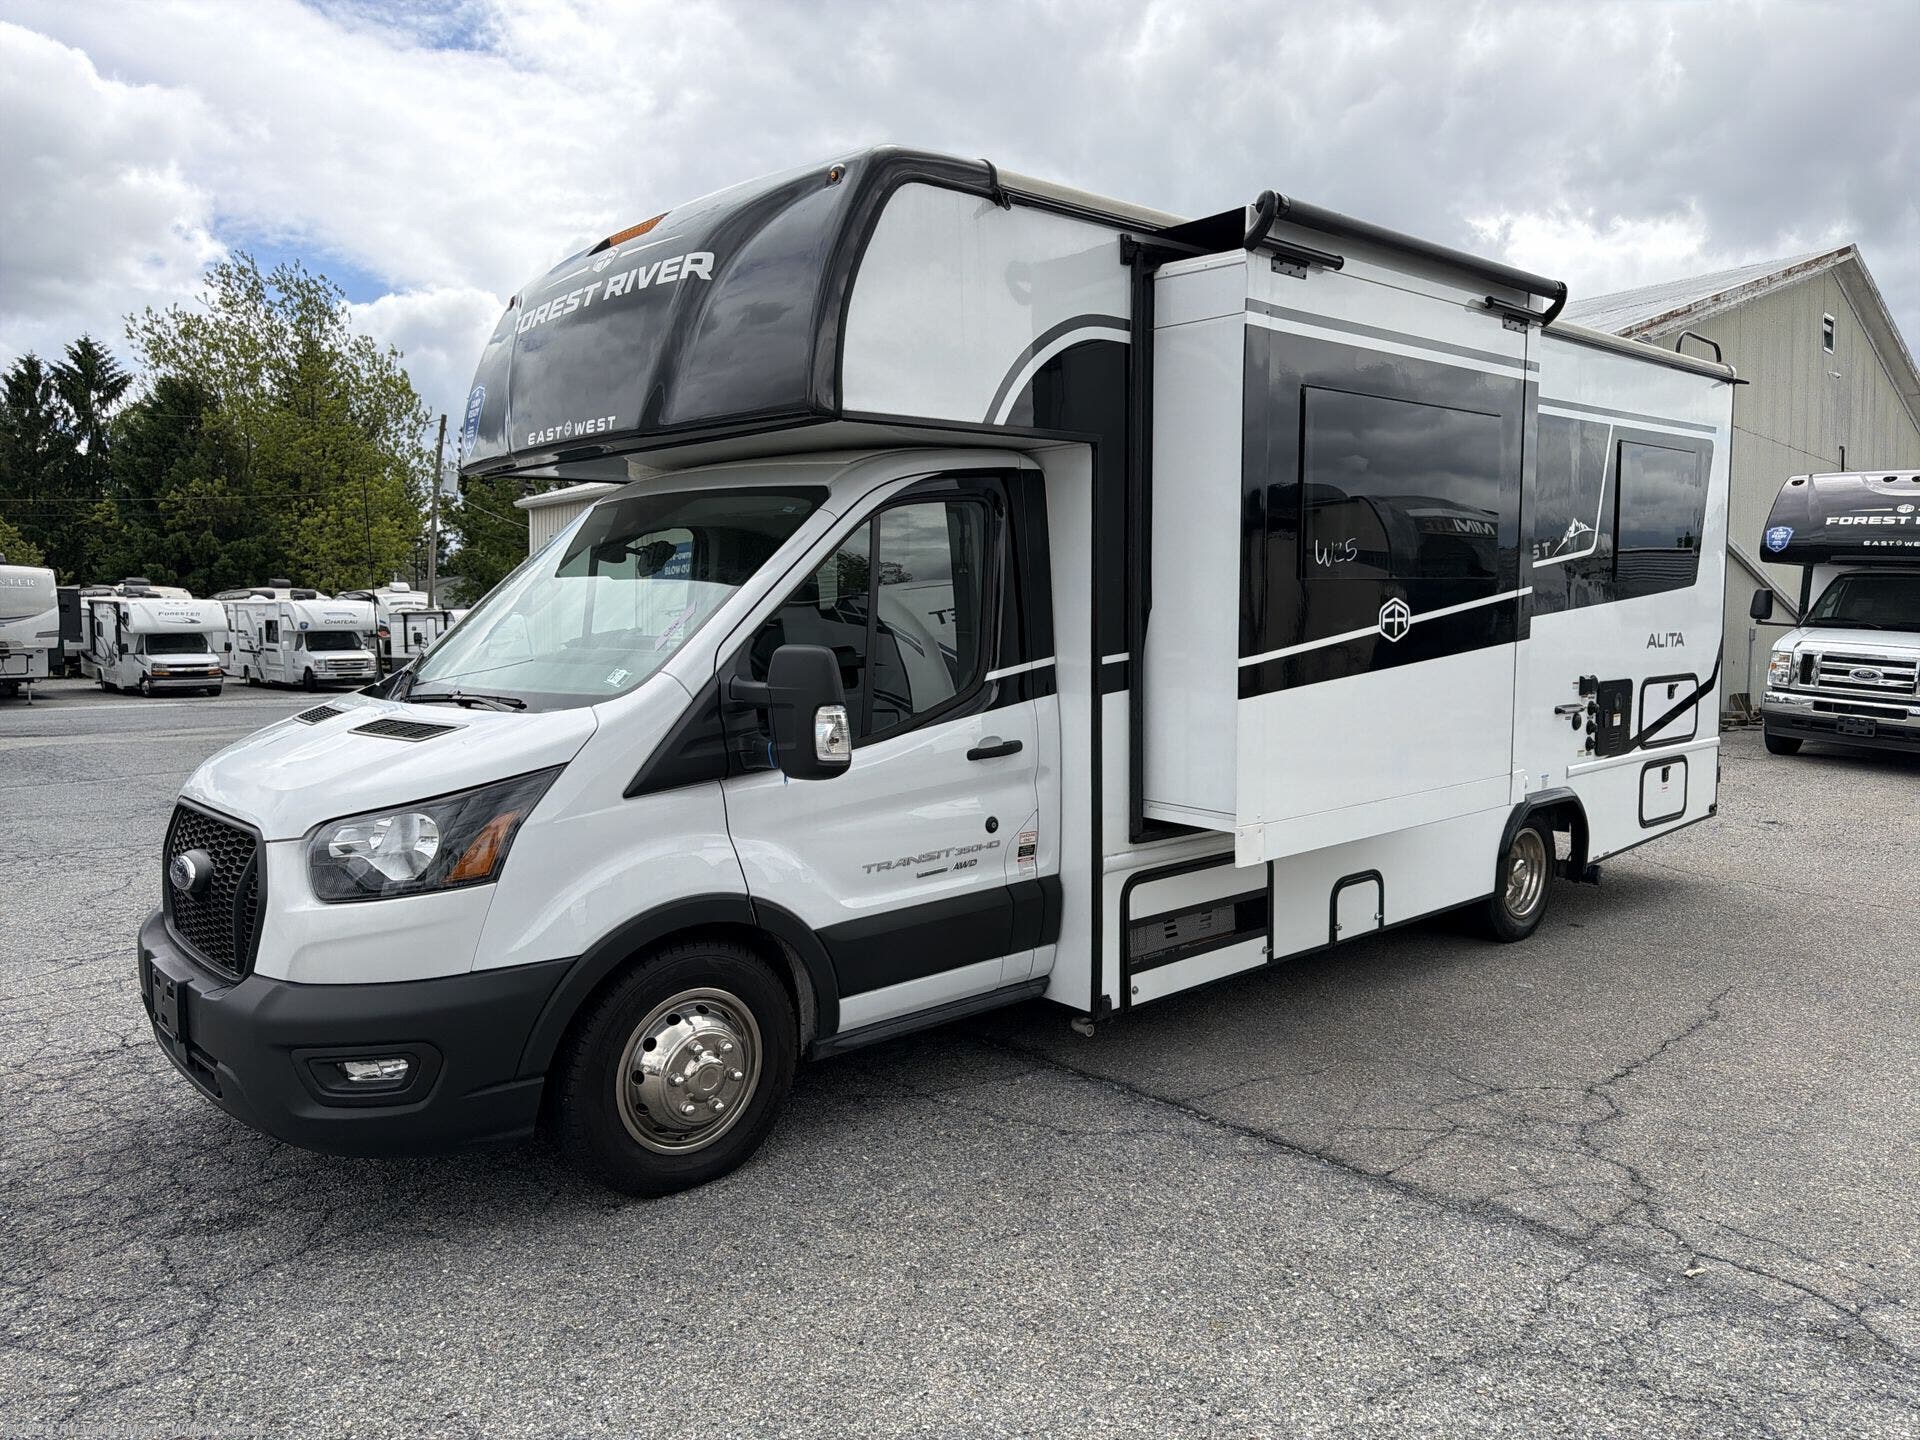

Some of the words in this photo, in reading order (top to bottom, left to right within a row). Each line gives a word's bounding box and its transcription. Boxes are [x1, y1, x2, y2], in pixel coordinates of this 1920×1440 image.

[603, 251, 715, 300] RIVER
[527, 426, 562, 446] EAST
[575, 415, 616, 436] WEST
[1826, 516, 1911, 525] FOREST
[1646, 631, 1685, 649] ALITA
[862, 847, 955, 874] TRANSIT
[951, 858, 978, 871] AWD
